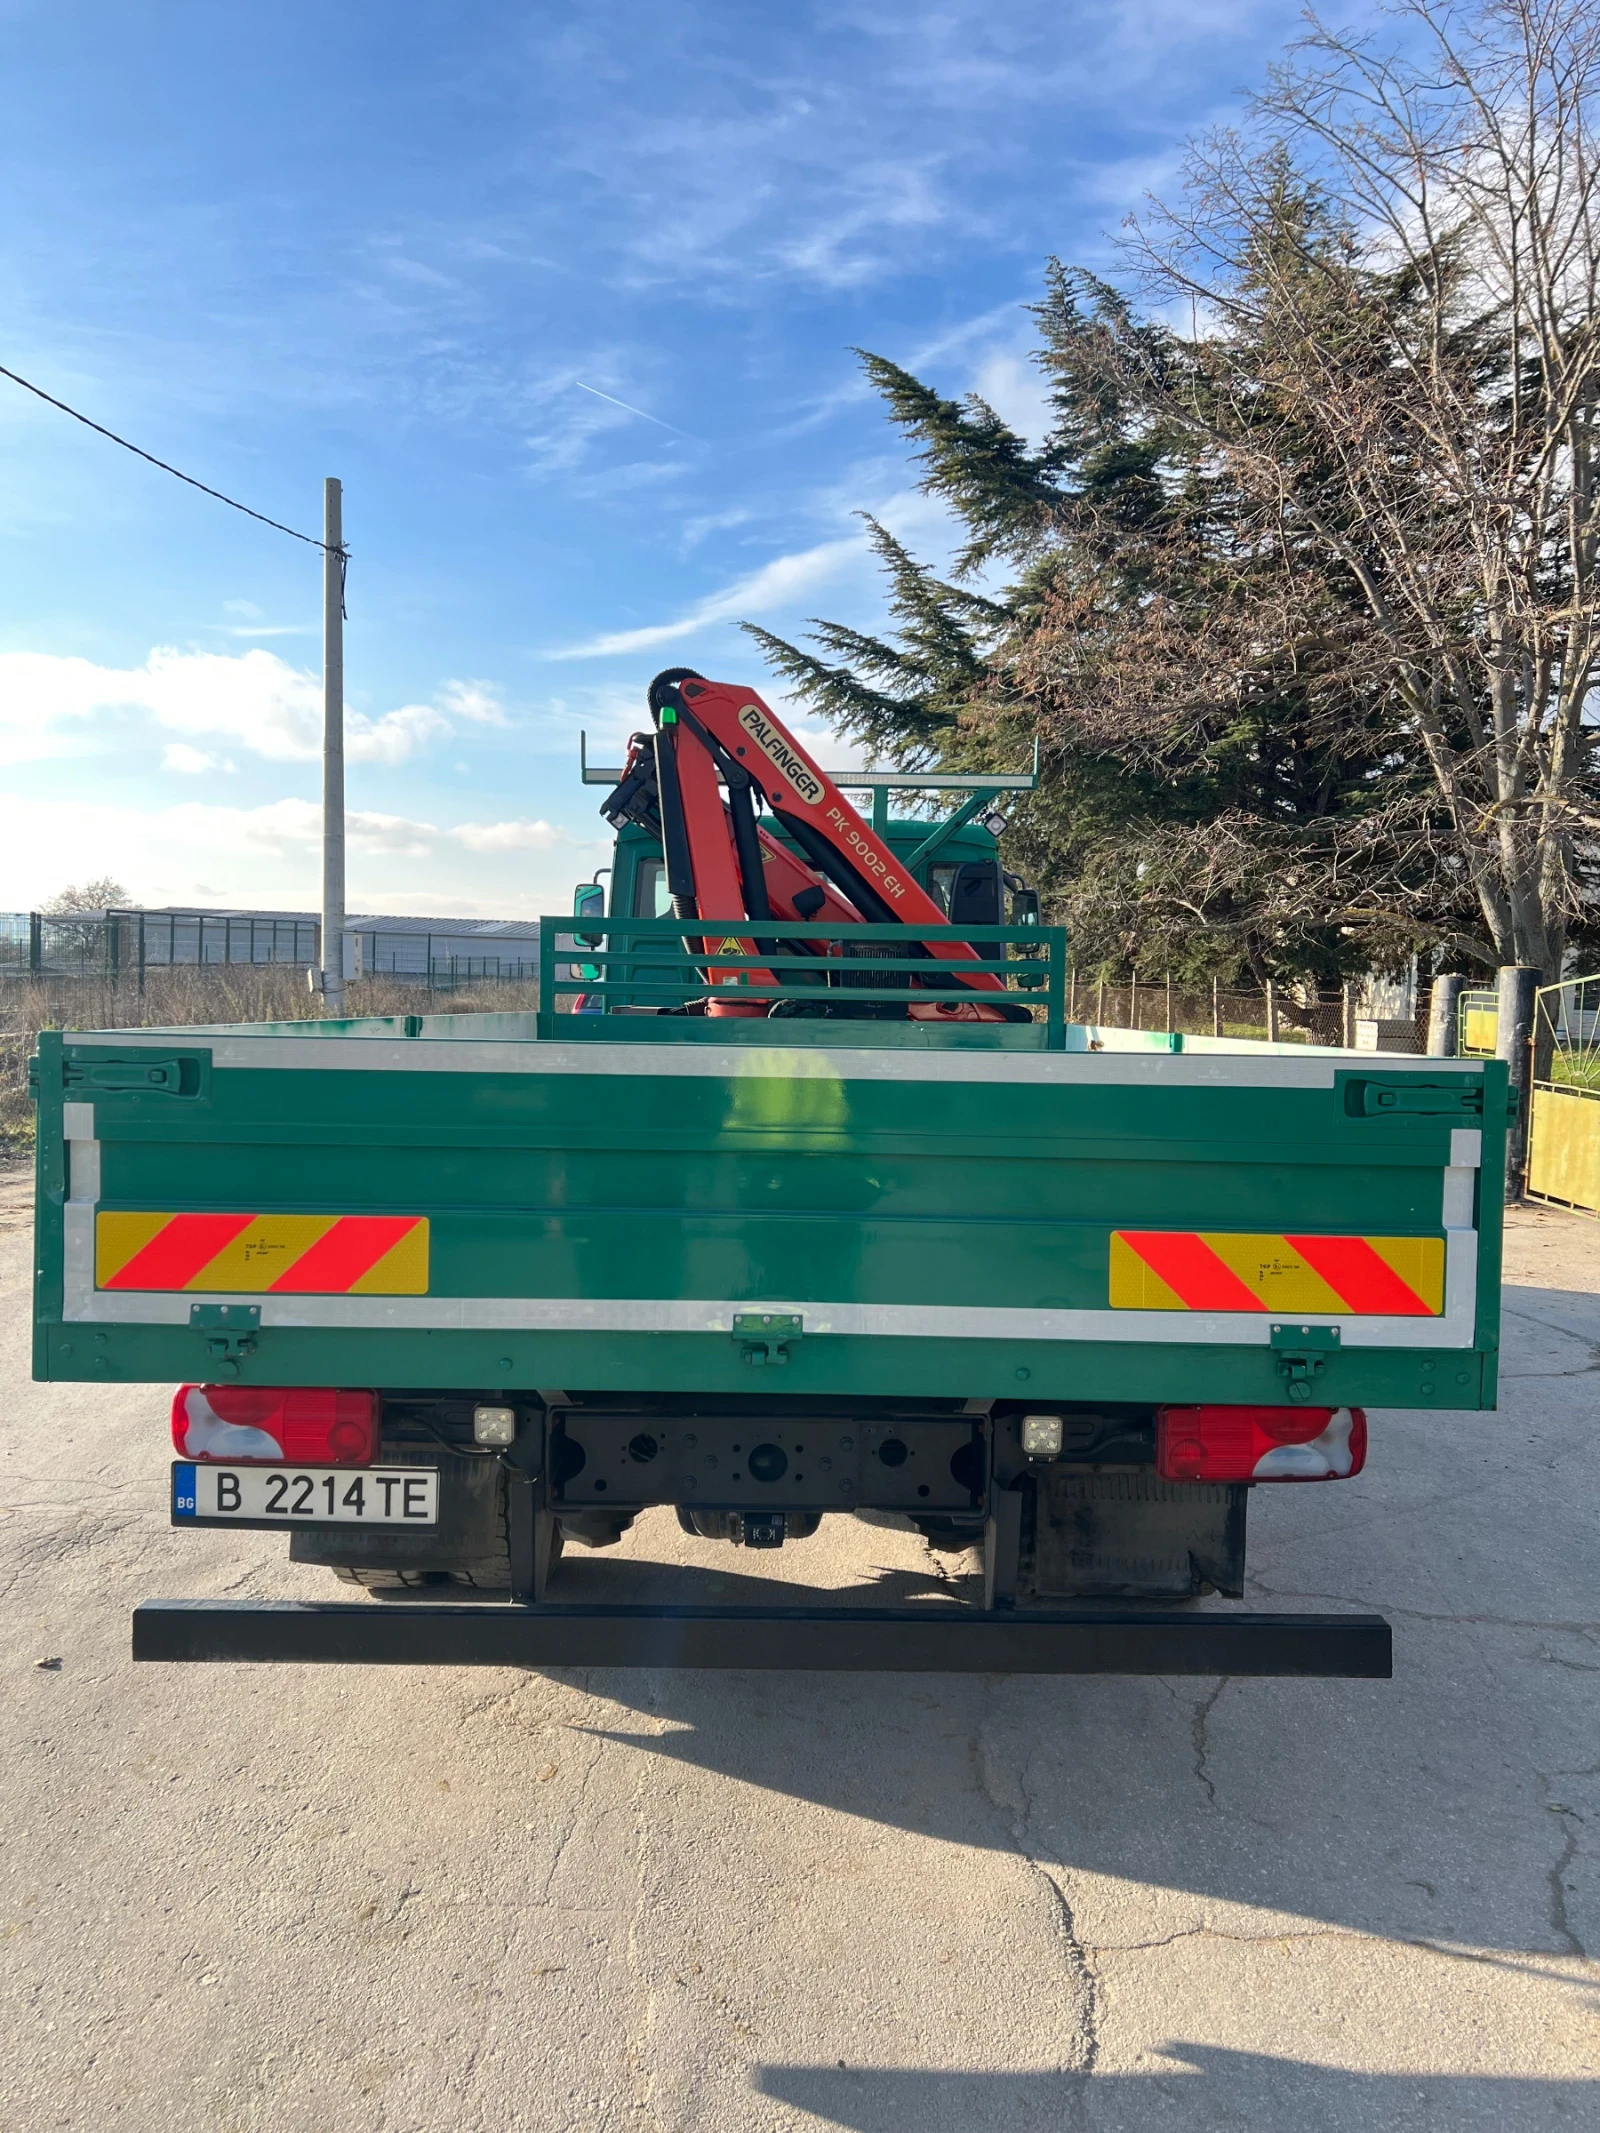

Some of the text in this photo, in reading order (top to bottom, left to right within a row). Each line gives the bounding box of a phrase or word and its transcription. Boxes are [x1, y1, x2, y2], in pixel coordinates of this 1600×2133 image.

[742, 709, 820, 800] PALFINGER
[826, 807, 850, 833] PK
[177, 1497, 194, 1509] BG
[217, 1472, 428, 1518] B 2214 TE
